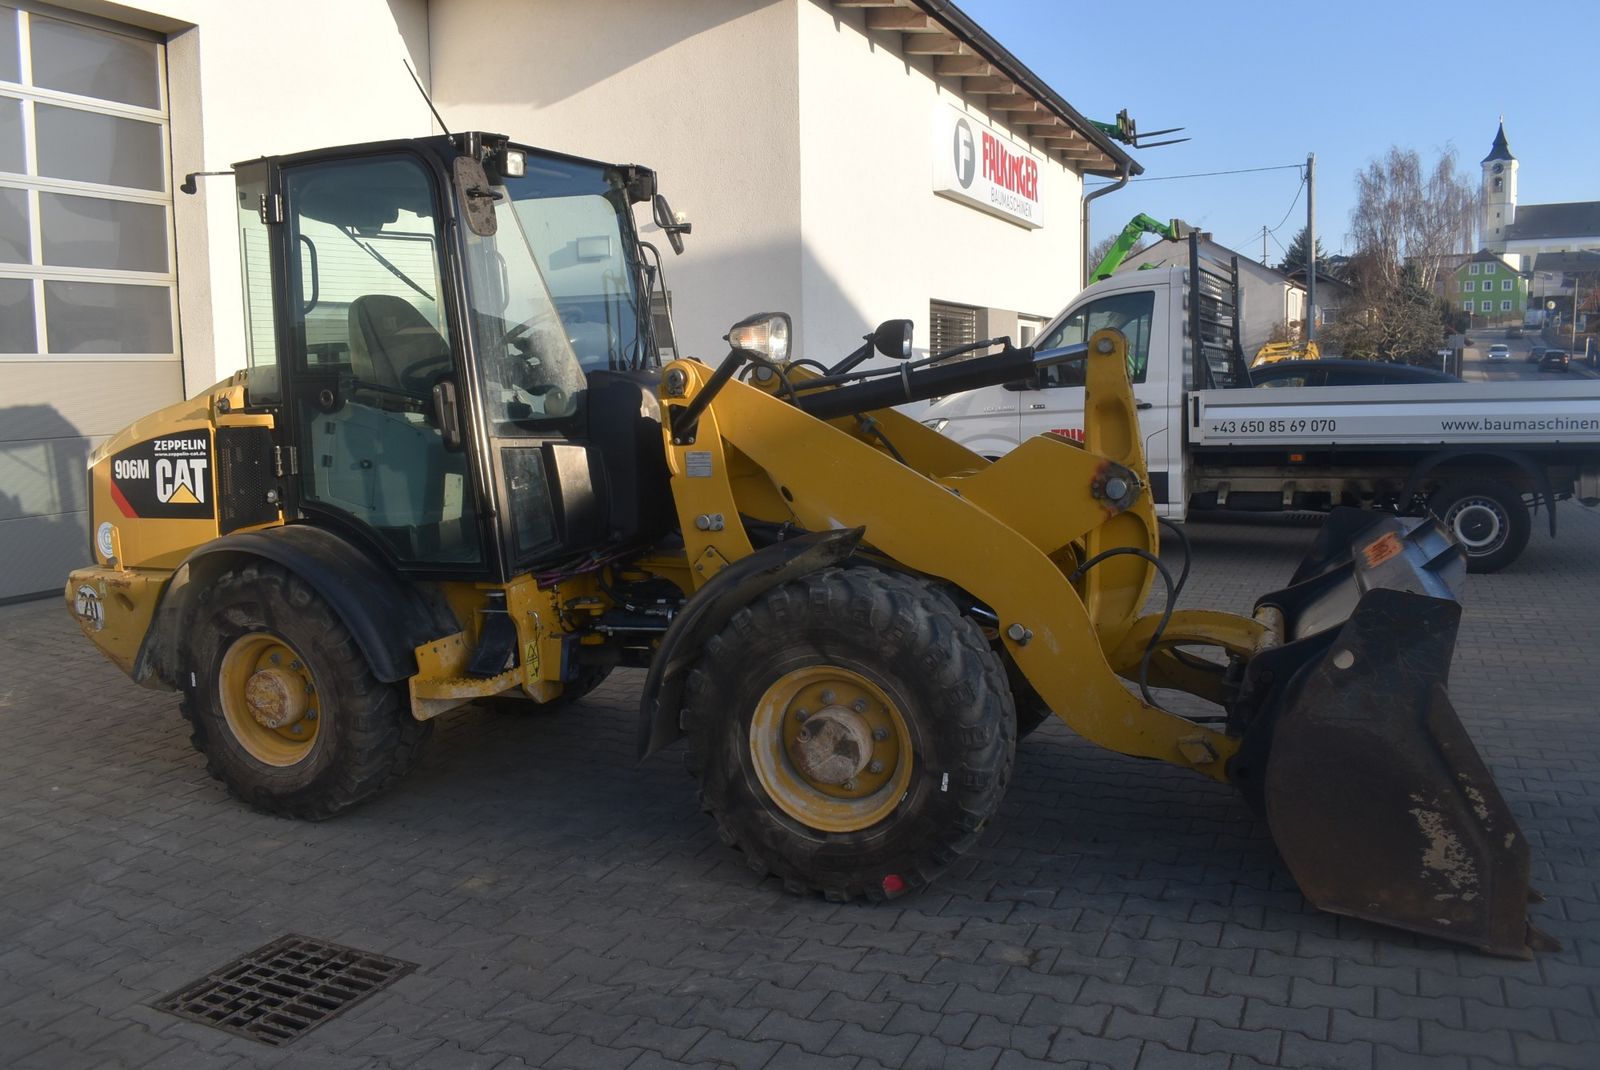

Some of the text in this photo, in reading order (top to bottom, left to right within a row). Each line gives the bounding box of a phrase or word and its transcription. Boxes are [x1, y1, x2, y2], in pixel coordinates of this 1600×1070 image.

[957, 122, 973, 183] F
[982, 130, 1038, 203] FALKINGER
[990, 187, 1032, 217] BAUMASCHINEN
[1212, 419, 1336, 433] +43 650 85 69 070
[154, 439, 206, 451] ZEPPELIN
[115, 459, 150, 479] 906M
[155, 458, 208, 503] CAT
